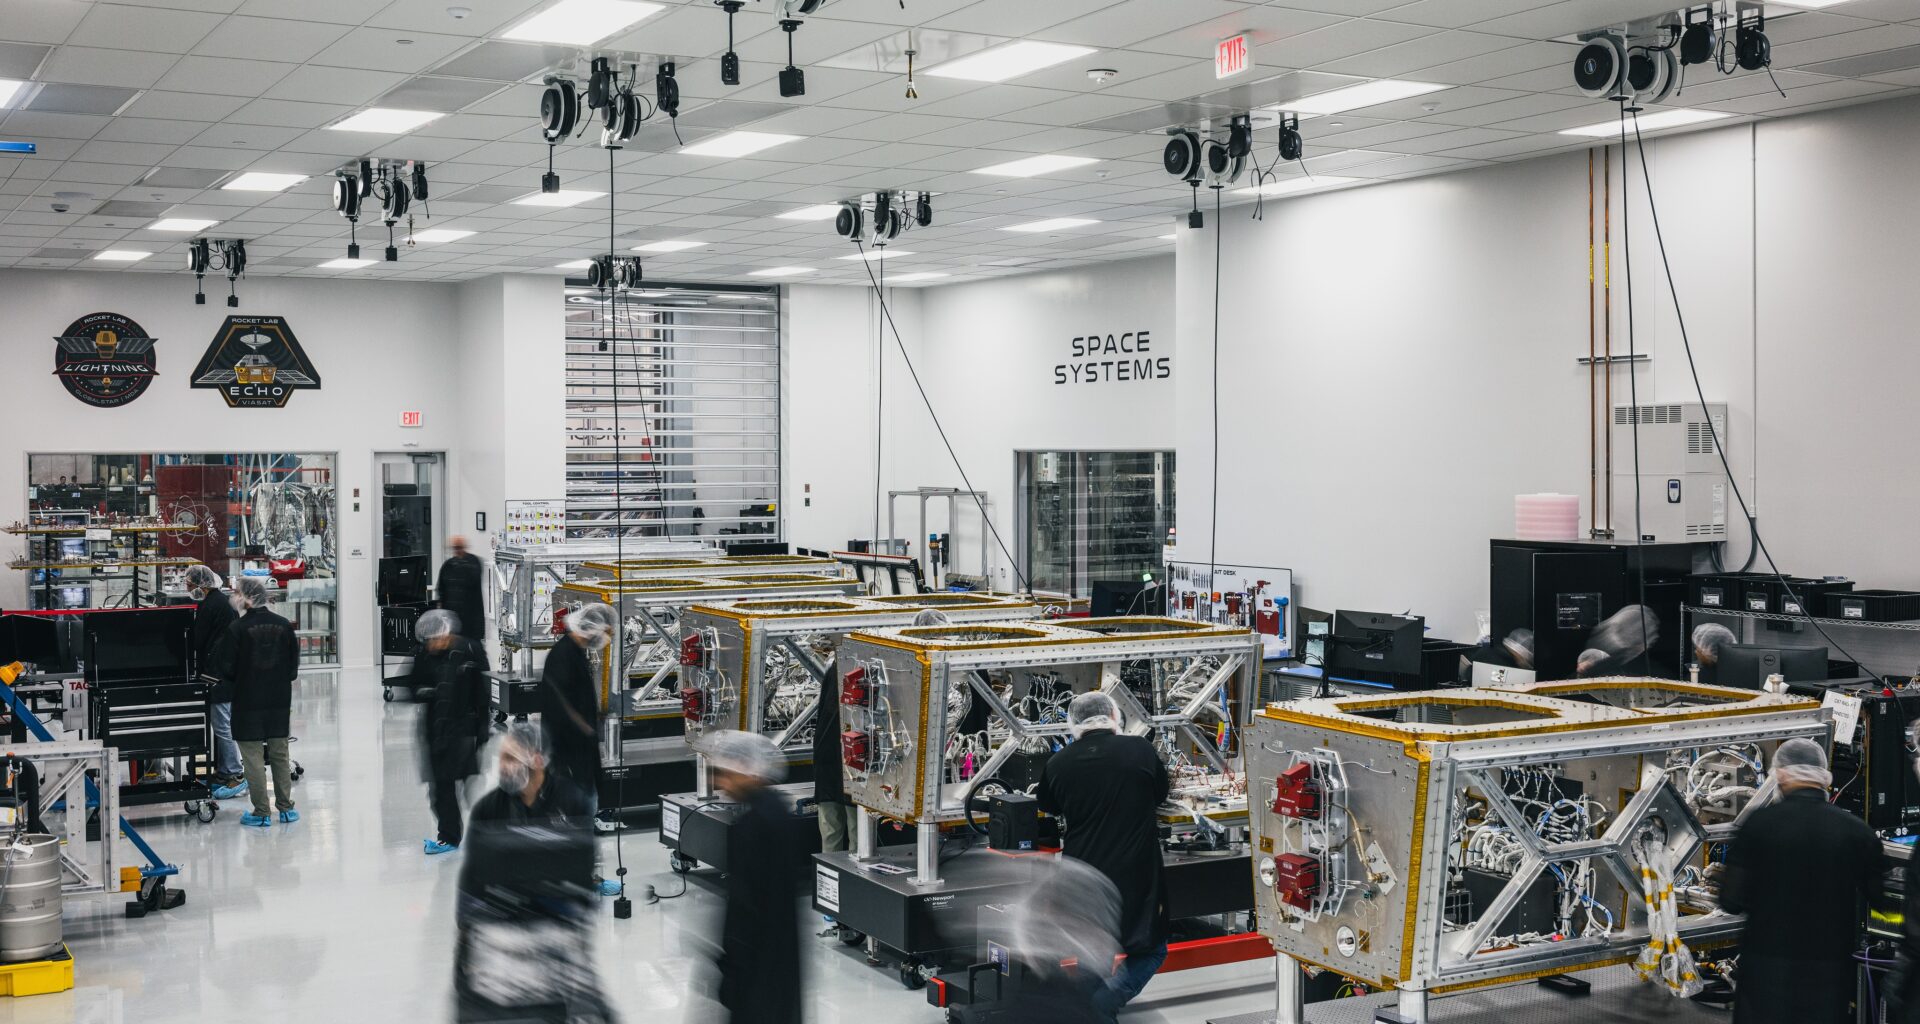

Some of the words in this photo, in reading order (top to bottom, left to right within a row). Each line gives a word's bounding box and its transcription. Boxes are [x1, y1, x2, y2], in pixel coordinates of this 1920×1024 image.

[1220, 36, 1243, 75] EXIT
[84, 315, 111, 324] ROCKET
[112, 316, 126, 324] LAB
[1072, 331, 1150, 357] SPACE
[64, 364, 149, 374] LIGHTNING
[1054, 357, 1171, 385] SYSTEMS
[75, 389, 120, 404] GLOBALSTAR
[125, 389, 140, 399] MDA
[230, 386, 283, 396] ECHO
[403, 411, 420, 425] EXIT
[932, 894, 955, 902] Newport
